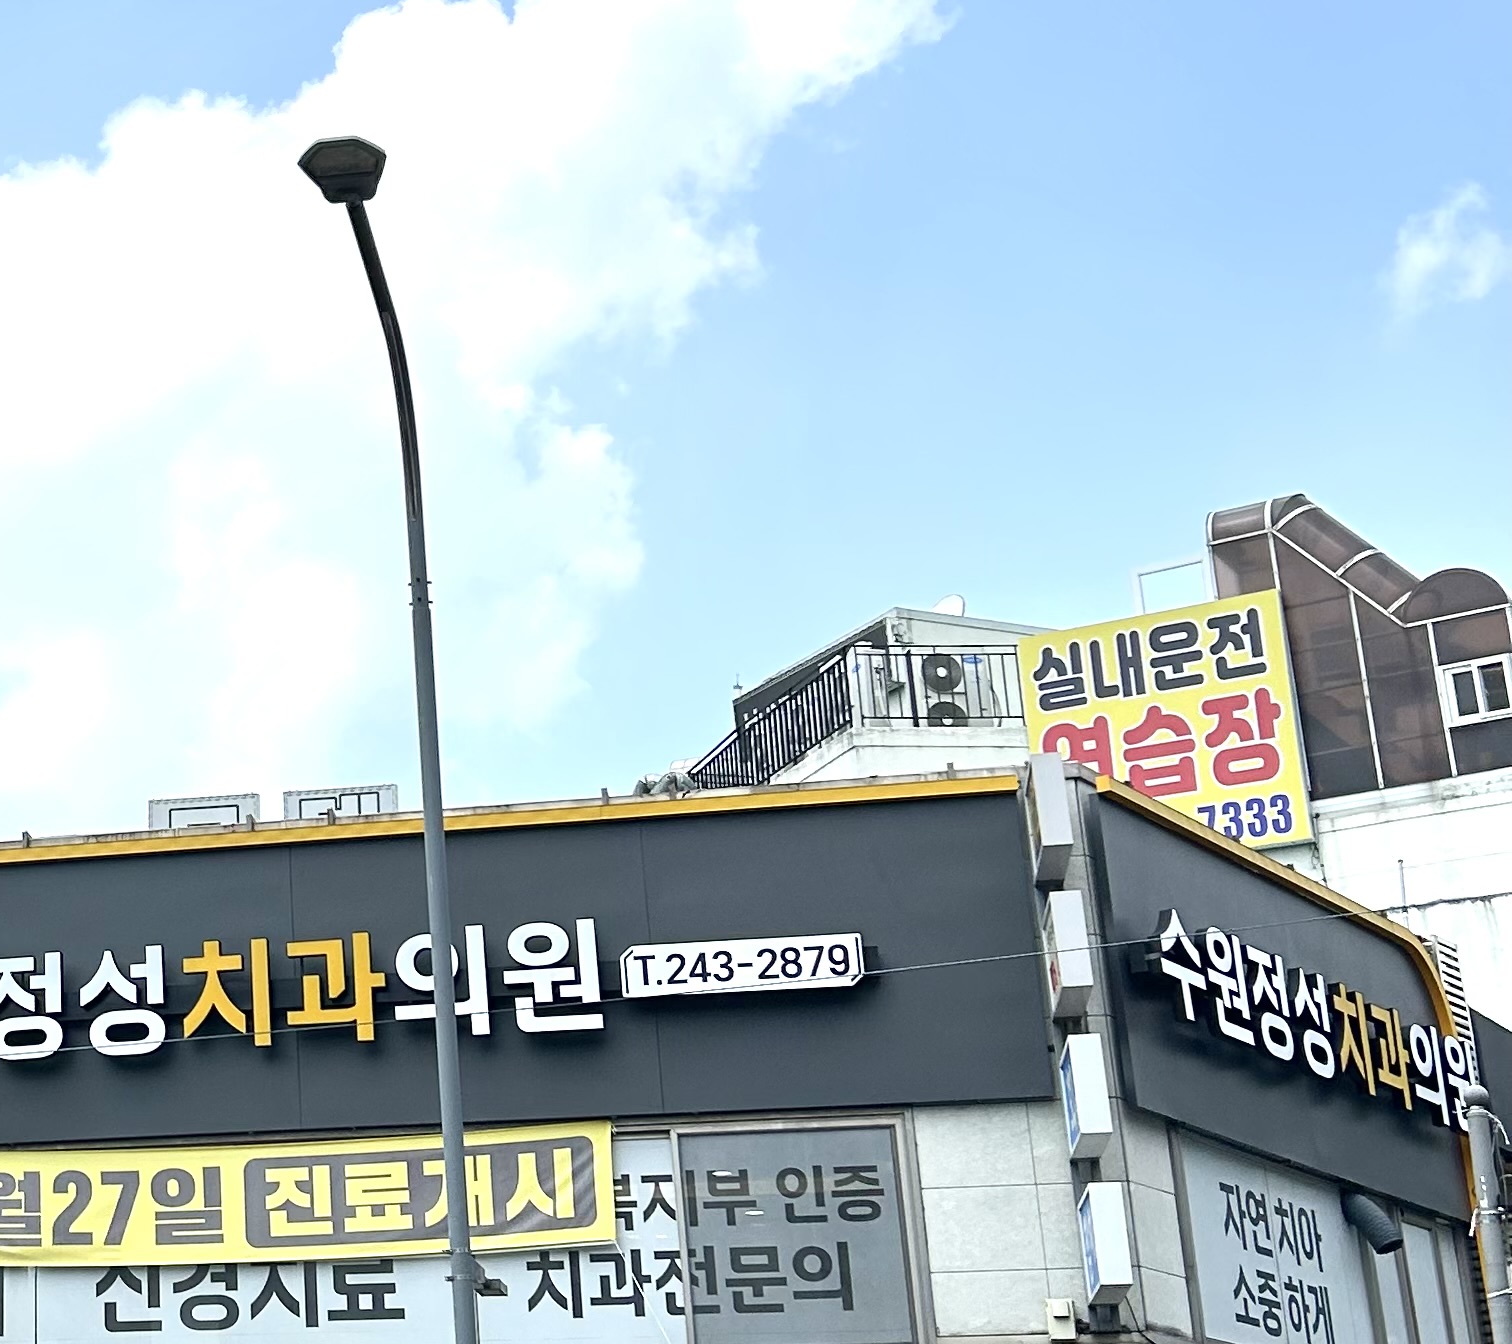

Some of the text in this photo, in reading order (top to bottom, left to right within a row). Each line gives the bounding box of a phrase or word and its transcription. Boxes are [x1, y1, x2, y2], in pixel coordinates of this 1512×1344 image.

[1034, 607, 1268, 713] 실내운전
[1042, 687, 1282, 797] 연습장
[632, 943, 851, 988] T.243-2879
[263, 1147, 576, 1239] 진료개시
[775, 1163, 886, 1225] 인증
